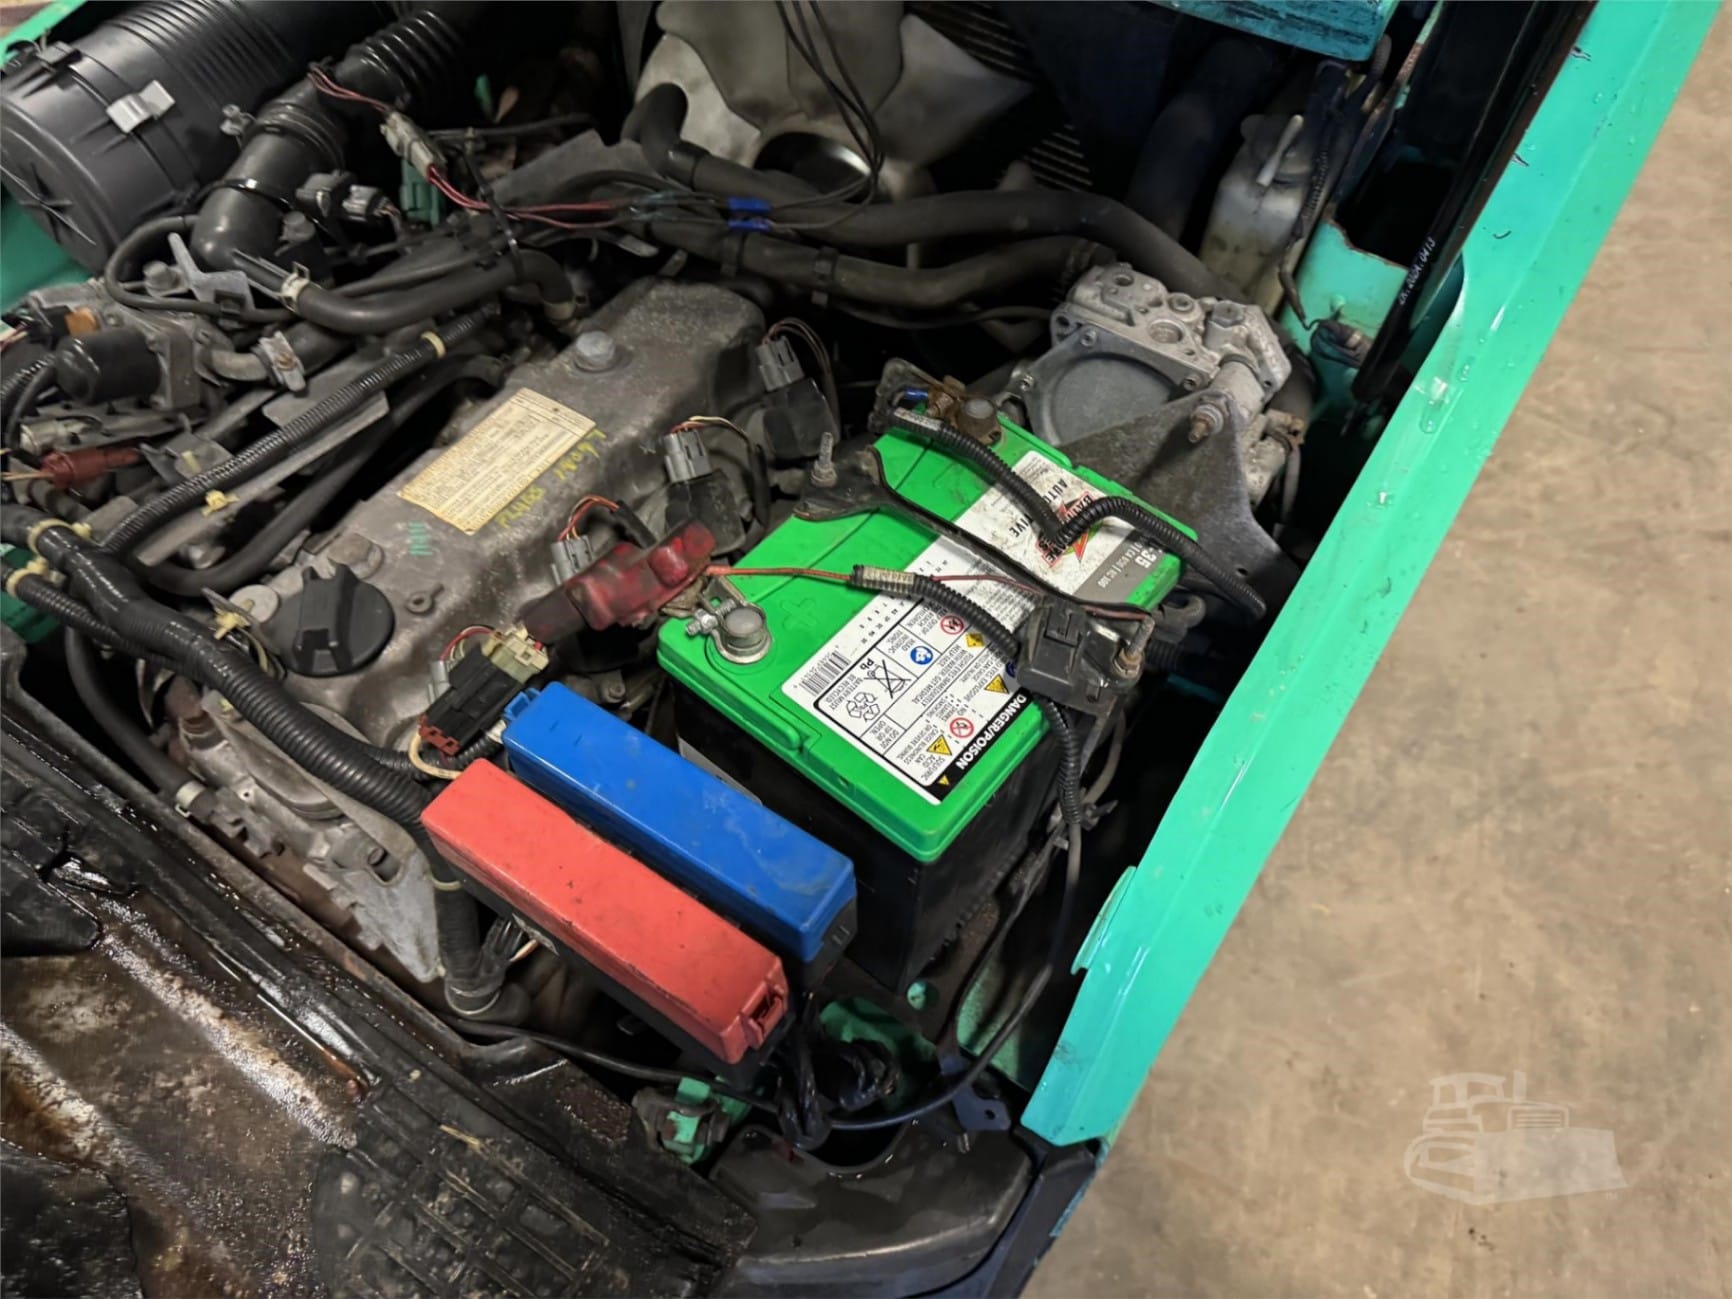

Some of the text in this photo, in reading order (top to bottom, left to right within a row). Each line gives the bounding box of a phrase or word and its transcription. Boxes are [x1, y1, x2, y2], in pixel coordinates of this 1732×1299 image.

[1007, 478, 1069, 537] AUTOTIVE
[859, 657, 874, 671] Pb
[879, 729, 899, 749] DO NOT
[954, 693, 1027, 769] DANGER/POISON
[914, 753, 925, 763] CAN
[921, 755, 935, 768] ACID
